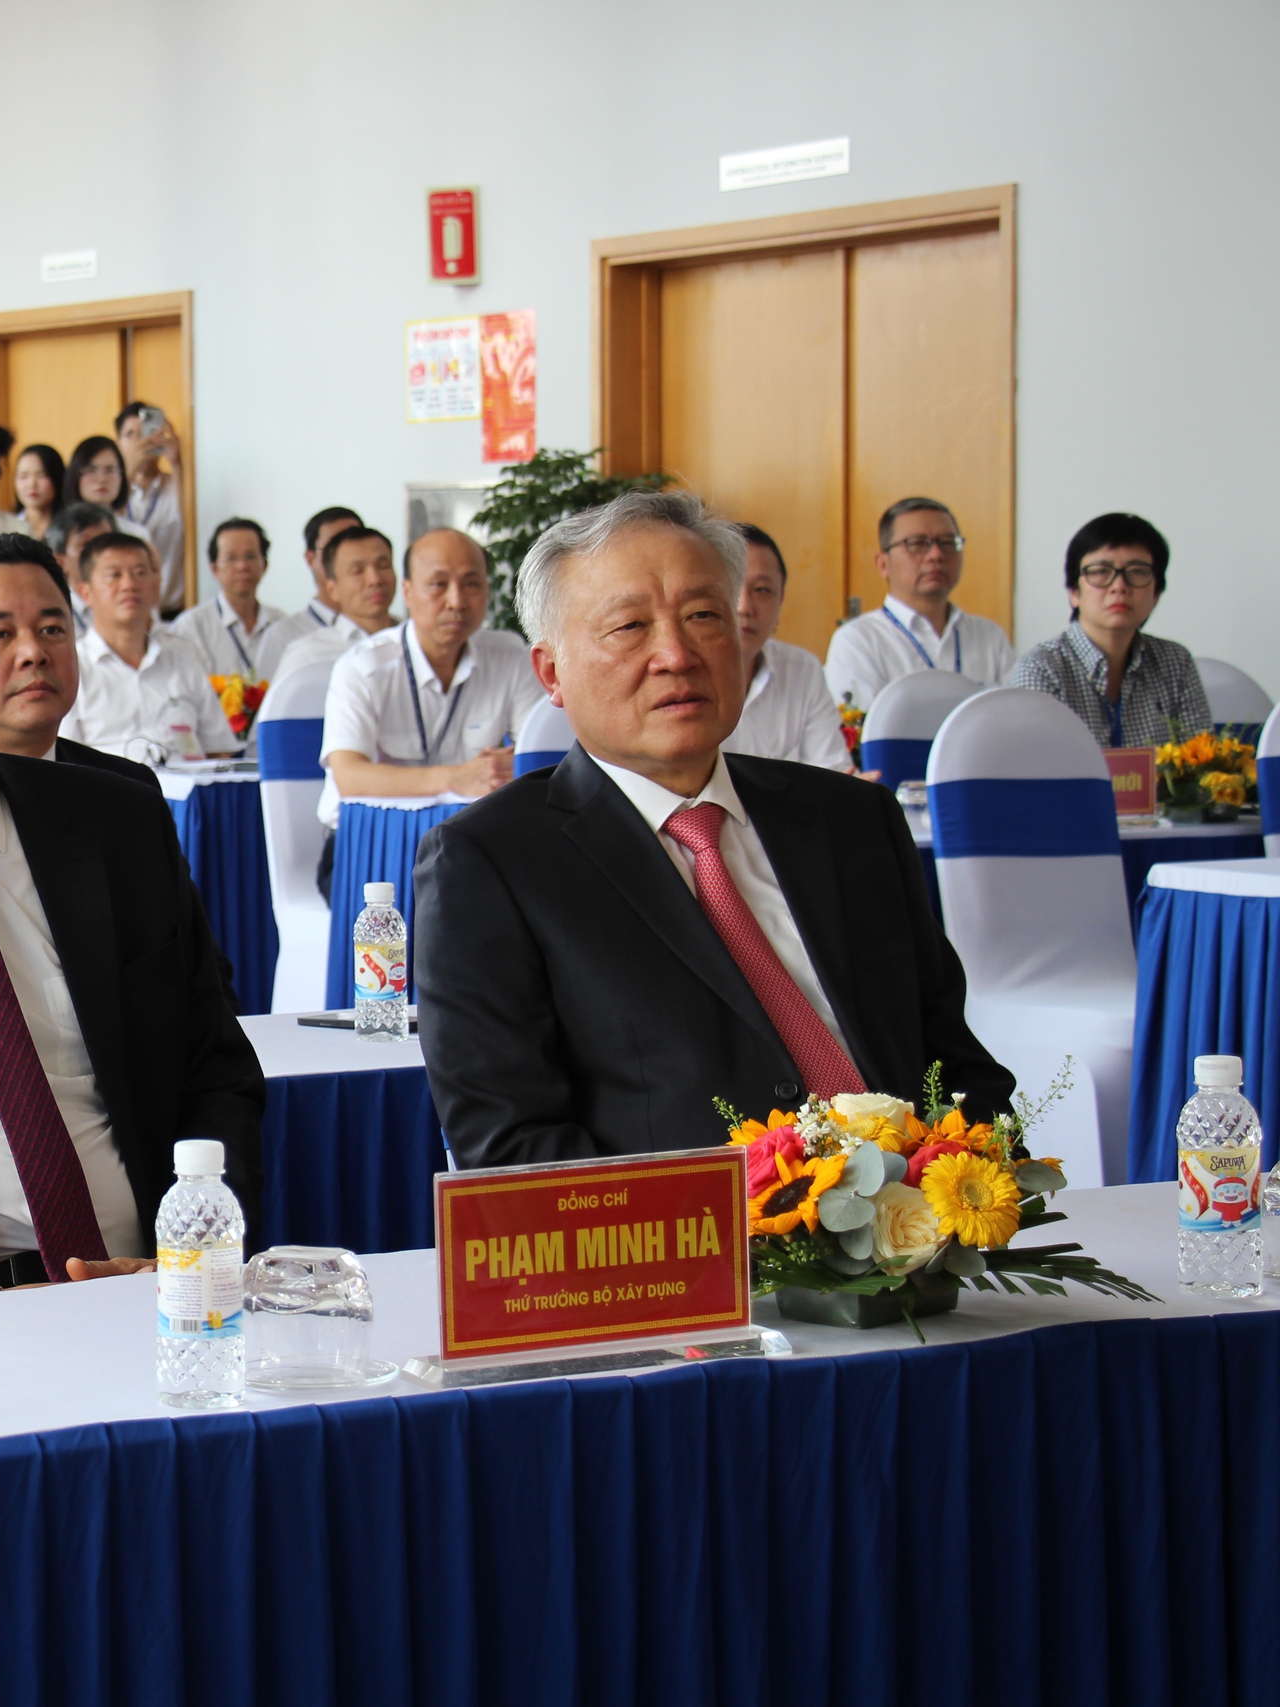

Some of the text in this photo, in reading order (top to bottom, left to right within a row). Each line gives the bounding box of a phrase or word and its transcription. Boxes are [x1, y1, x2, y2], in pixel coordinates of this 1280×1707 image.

[1210, 1155, 1246, 1171] SAPUWA
[558, 1188, 628, 1211] ĐỒNG CHÍ
[465, 1207, 720, 1285] PHẠM MINH HÀ
[504, 1281, 686, 1313] THỨ TRƯỞNG BỘ XÂY DỰNG
